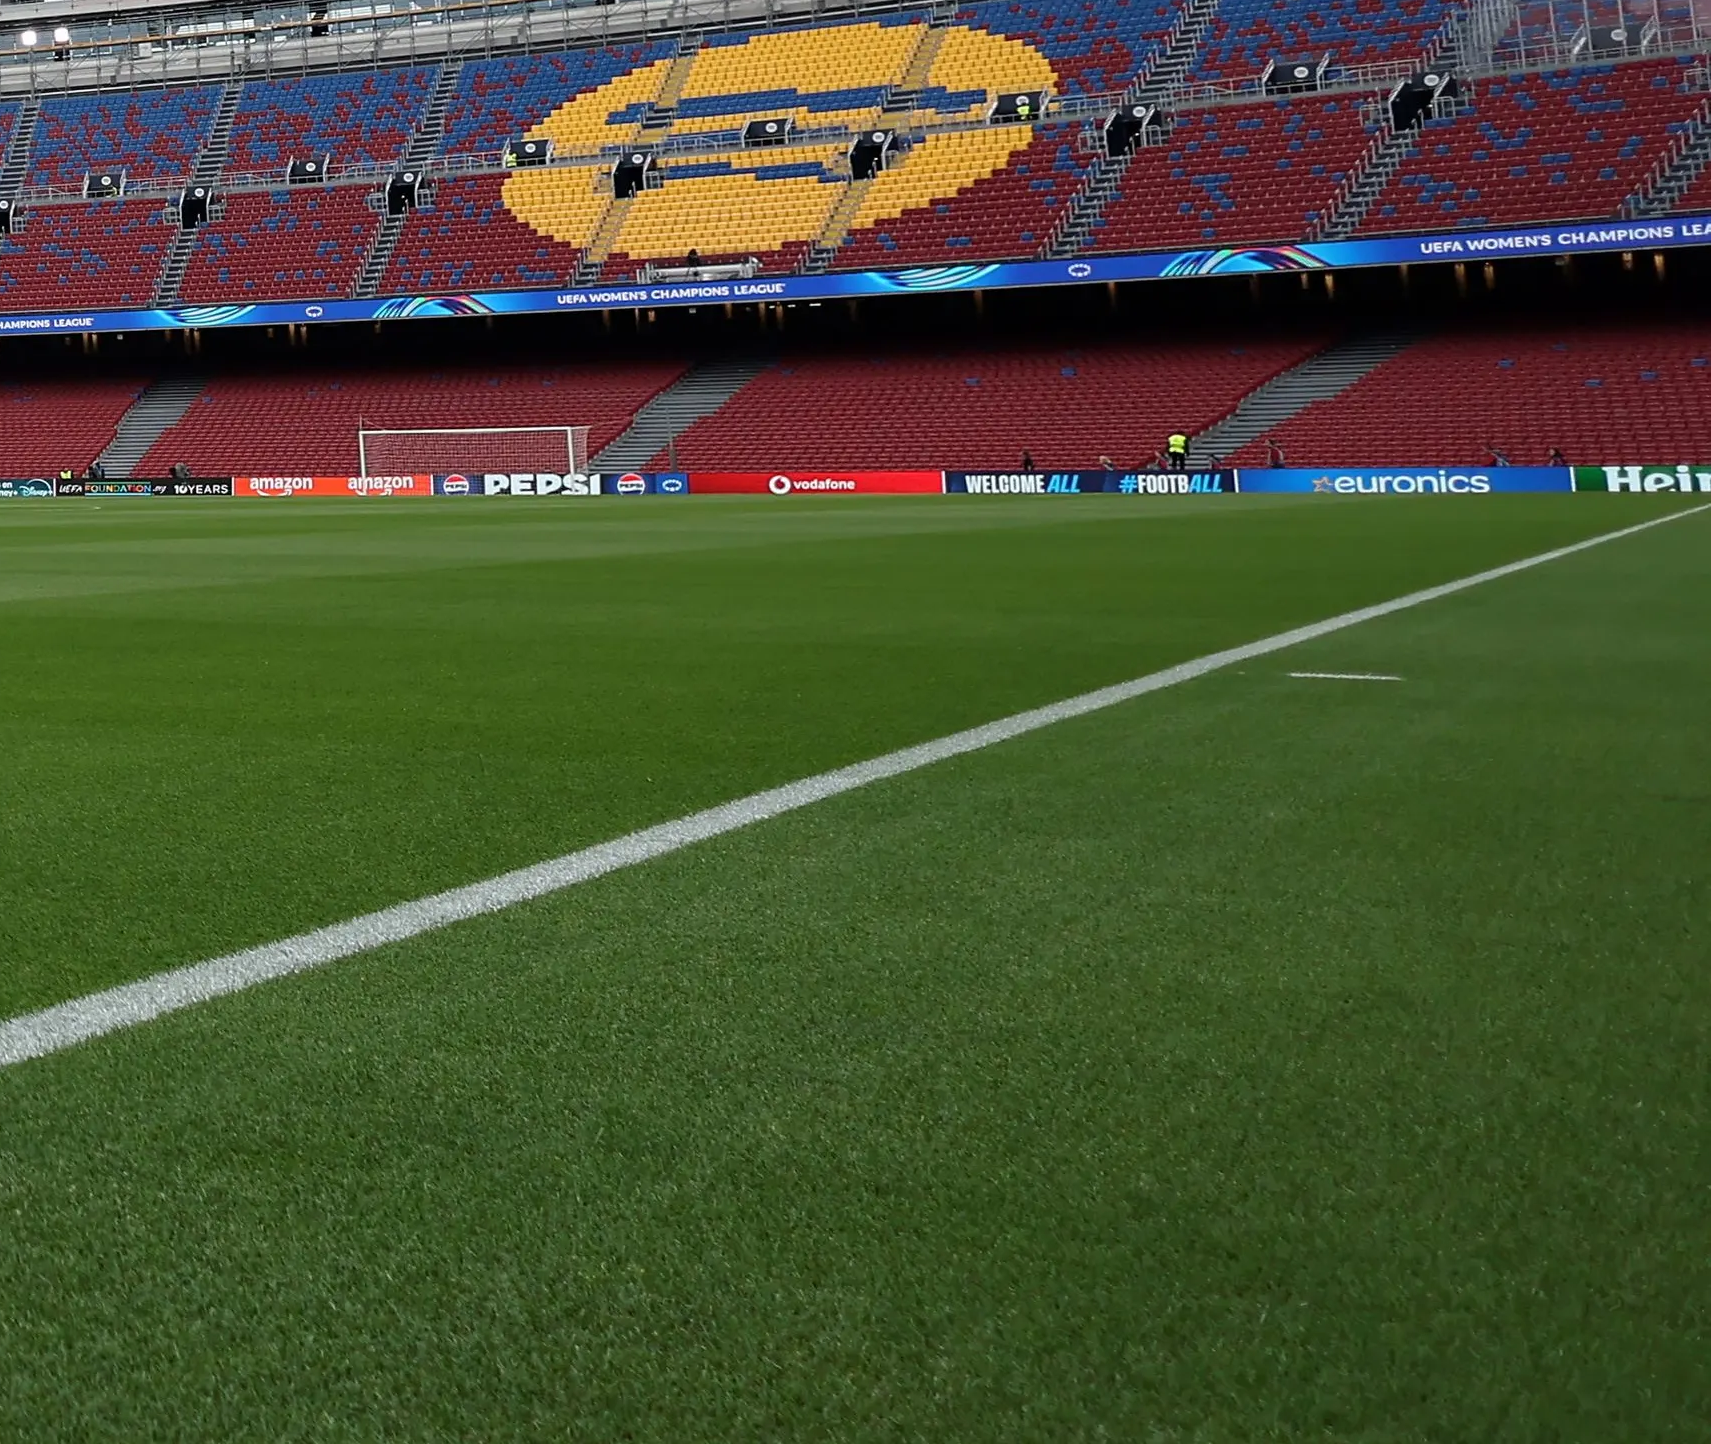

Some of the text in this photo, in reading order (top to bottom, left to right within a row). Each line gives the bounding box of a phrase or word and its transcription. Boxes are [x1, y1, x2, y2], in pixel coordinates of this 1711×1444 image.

[1420, 240, 1463, 254] UEFA
[1465, 234, 1552, 251] WOMEN'S
[1557, 225, 1674, 246] CHAMPIONS
[557, 294, 588, 305] UEFA
[589, 290, 648, 303] WOMEN'S
[651, 286, 730, 299] CHAMPIONS
[59, 484, 82, 493] UEFA
[84, 484, 152, 493] FOUNDATION
[250, 477, 313, 490] amazon
[348, 476, 414, 489] amazon
[484, 474, 601, 495] PEPSI
[793, 478, 856, 490] vodafone
[965, 474, 1080, 494] WELCOME ALL
[1118, 473, 1222, 494] #FOOTBALL
[1334, 470, 1490, 493] euronics
